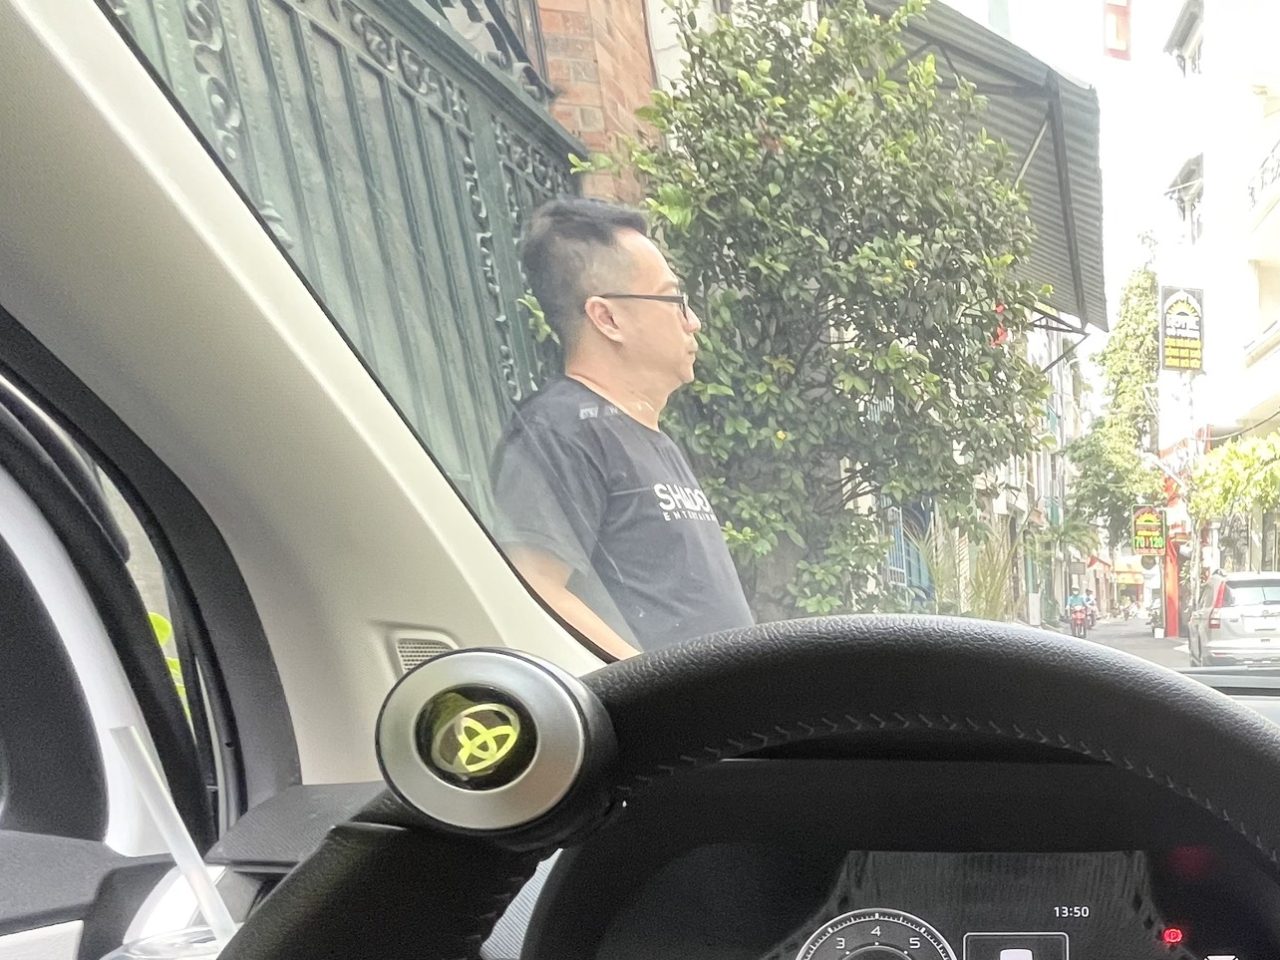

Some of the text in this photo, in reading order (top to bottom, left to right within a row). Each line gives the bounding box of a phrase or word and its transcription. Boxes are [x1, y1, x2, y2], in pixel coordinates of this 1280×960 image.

[1053, 906, 1090, 917] 13:50
[870, 926, 881, 937] 4
[836, 937, 846, 949] 3
[909, 937, 920, 948] 5
